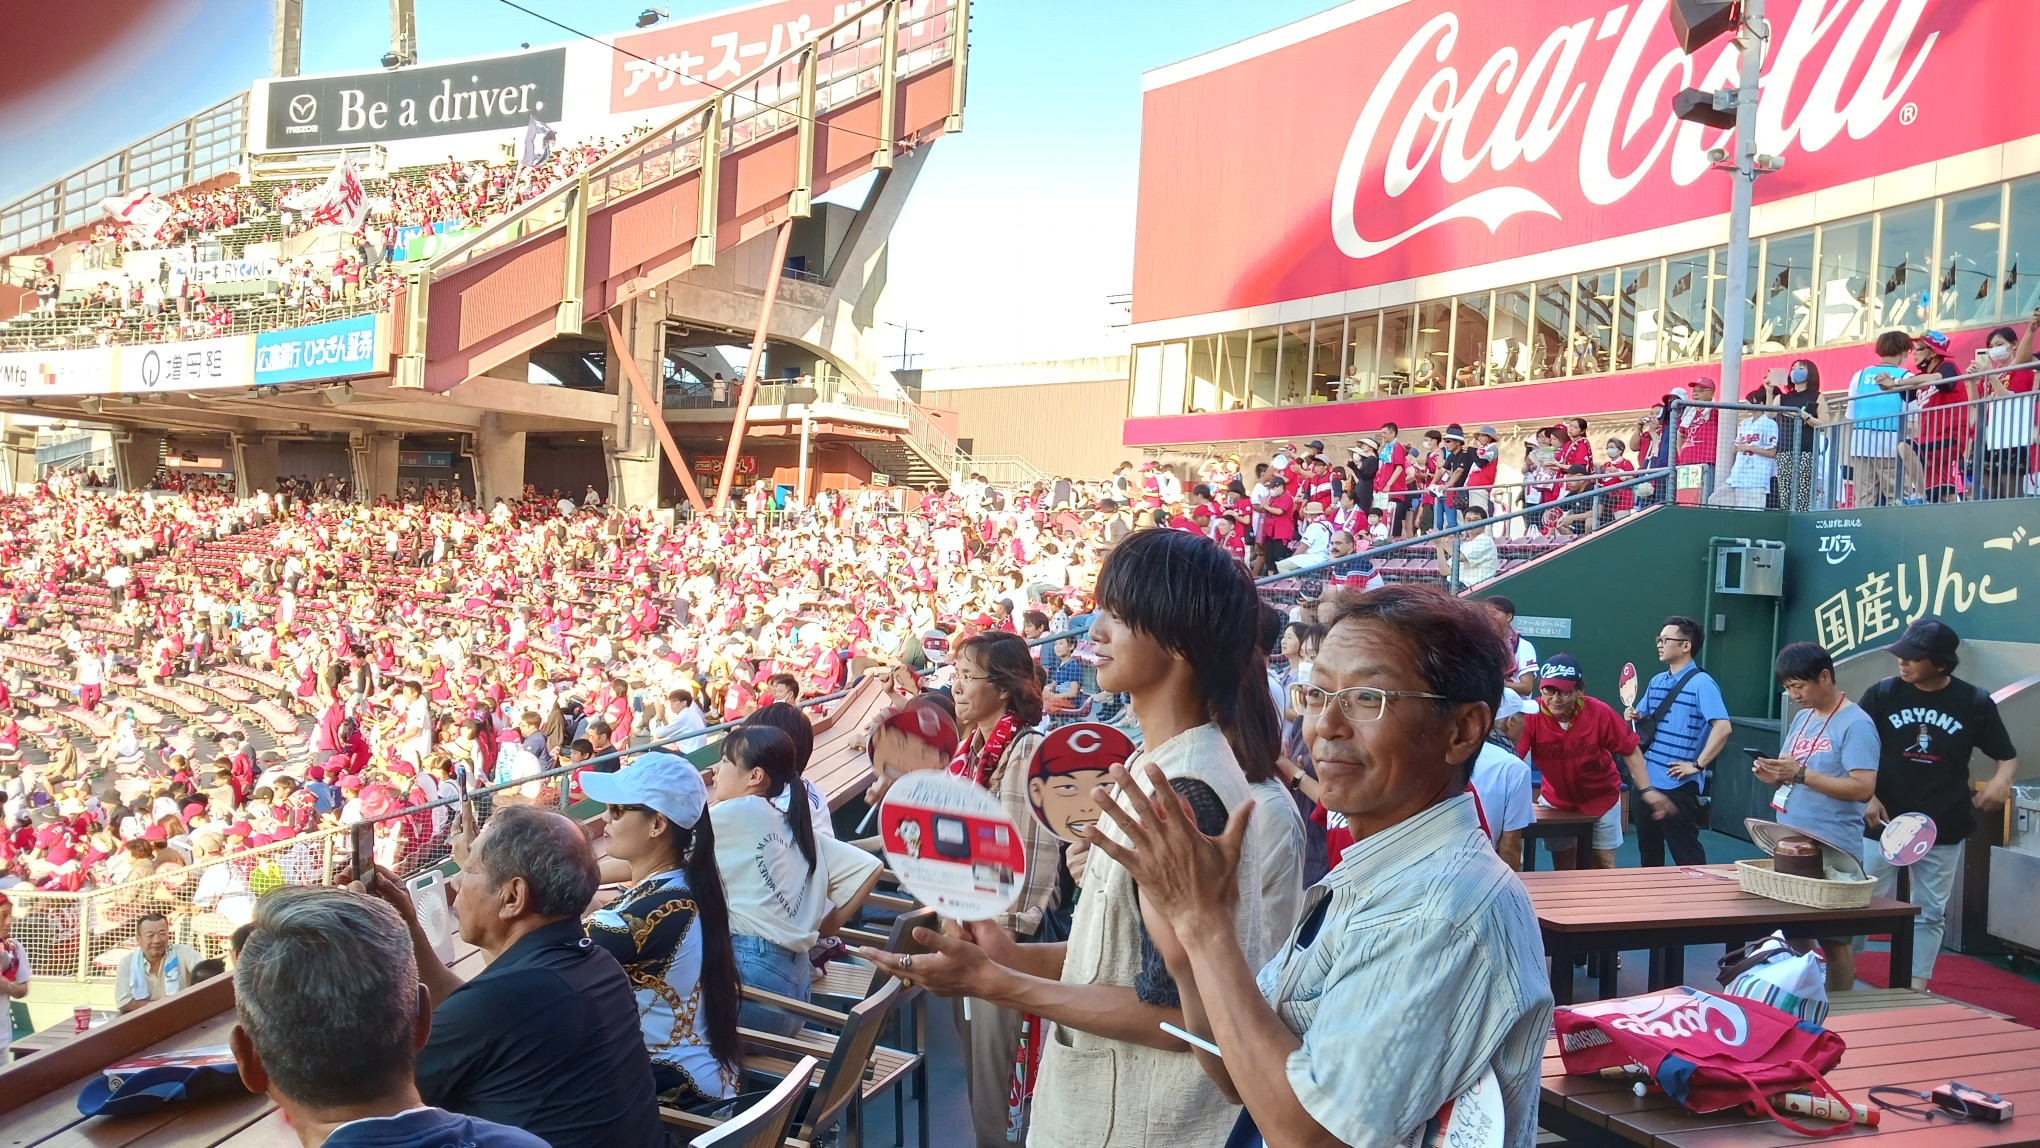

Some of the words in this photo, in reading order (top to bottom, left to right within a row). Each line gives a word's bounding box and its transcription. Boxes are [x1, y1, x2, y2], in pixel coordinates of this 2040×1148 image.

[337, 89, 388, 132] Be
[399, 98, 417, 127] a
[429, 74, 544, 123] driver.
[1331, 0, 1942, 258] Coca-Cola
[0, 365, 27, 387] Mfg
[1818, 534, 1856, 553] エバラ
[1815, 526, 2040, 658] 国産りんご
[1540, 662, 1576, 679] Carp
[1888, 707, 1963, 735] BRYANT
[755, 854, 778, 892] MOMENT
